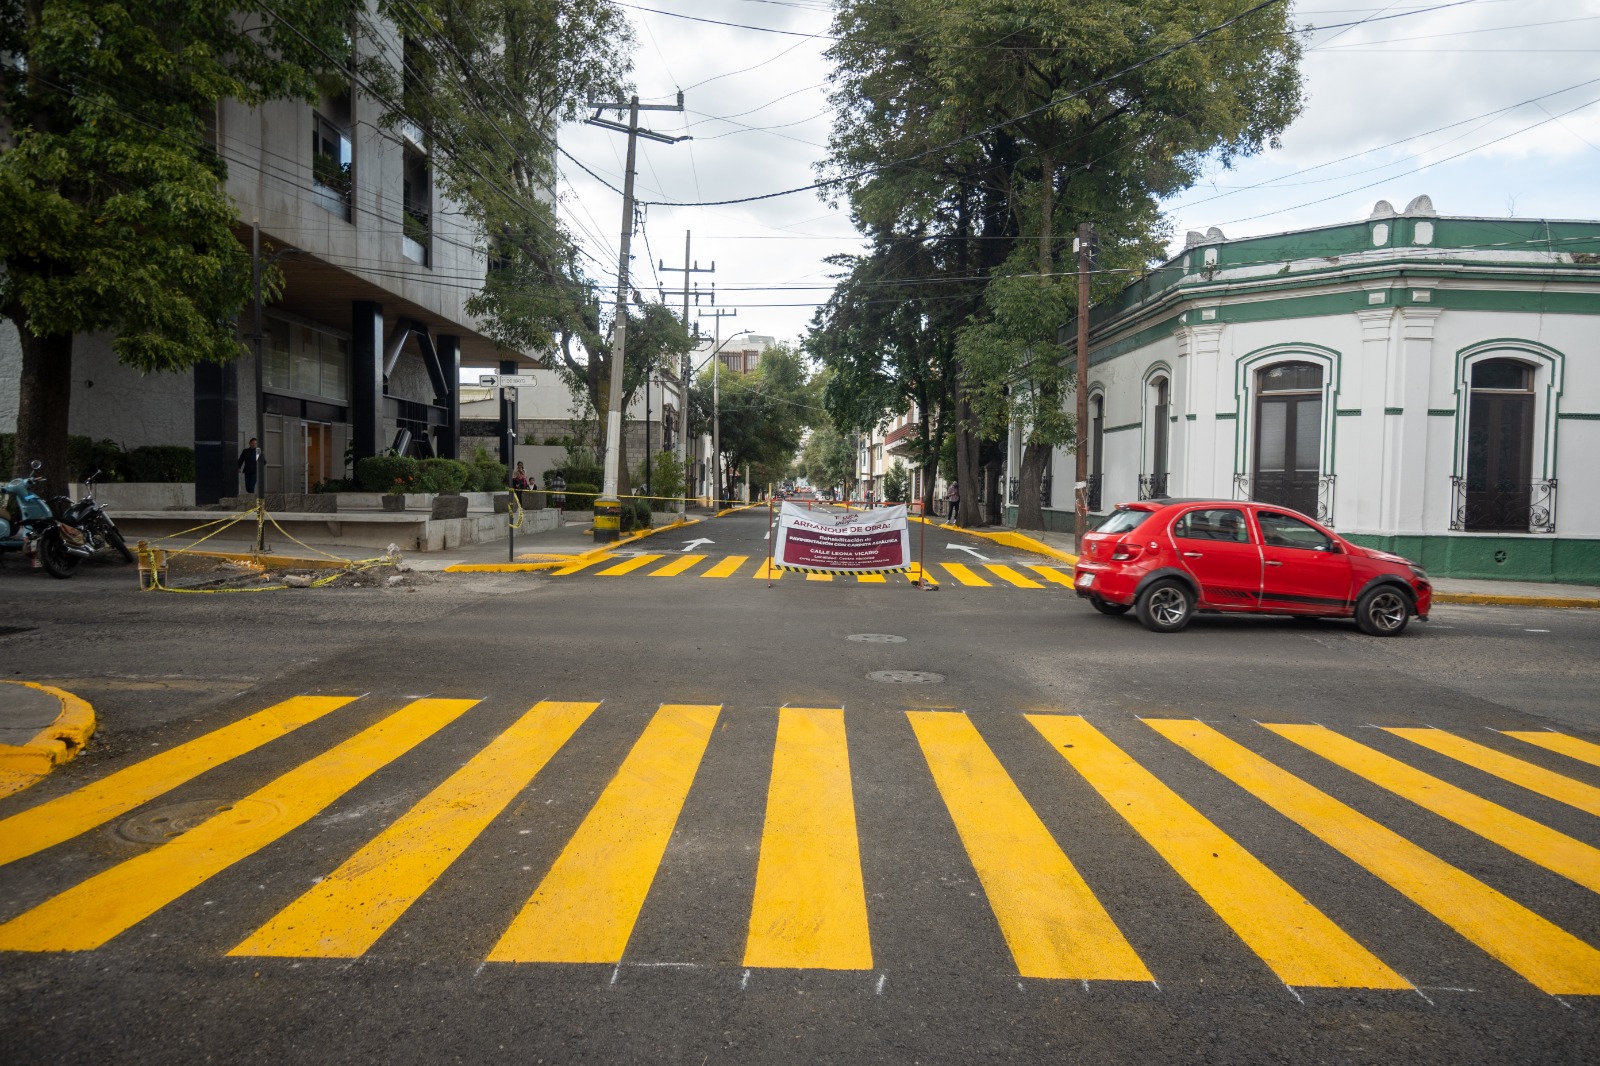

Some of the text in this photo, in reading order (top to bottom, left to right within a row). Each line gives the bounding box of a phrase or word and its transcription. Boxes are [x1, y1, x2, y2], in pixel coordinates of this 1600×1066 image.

[793, 519, 848, 534] ARRANQUE
[864, 523, 891, 532] OBRA:
[819, 535, 864, 543] Rehabilitación
